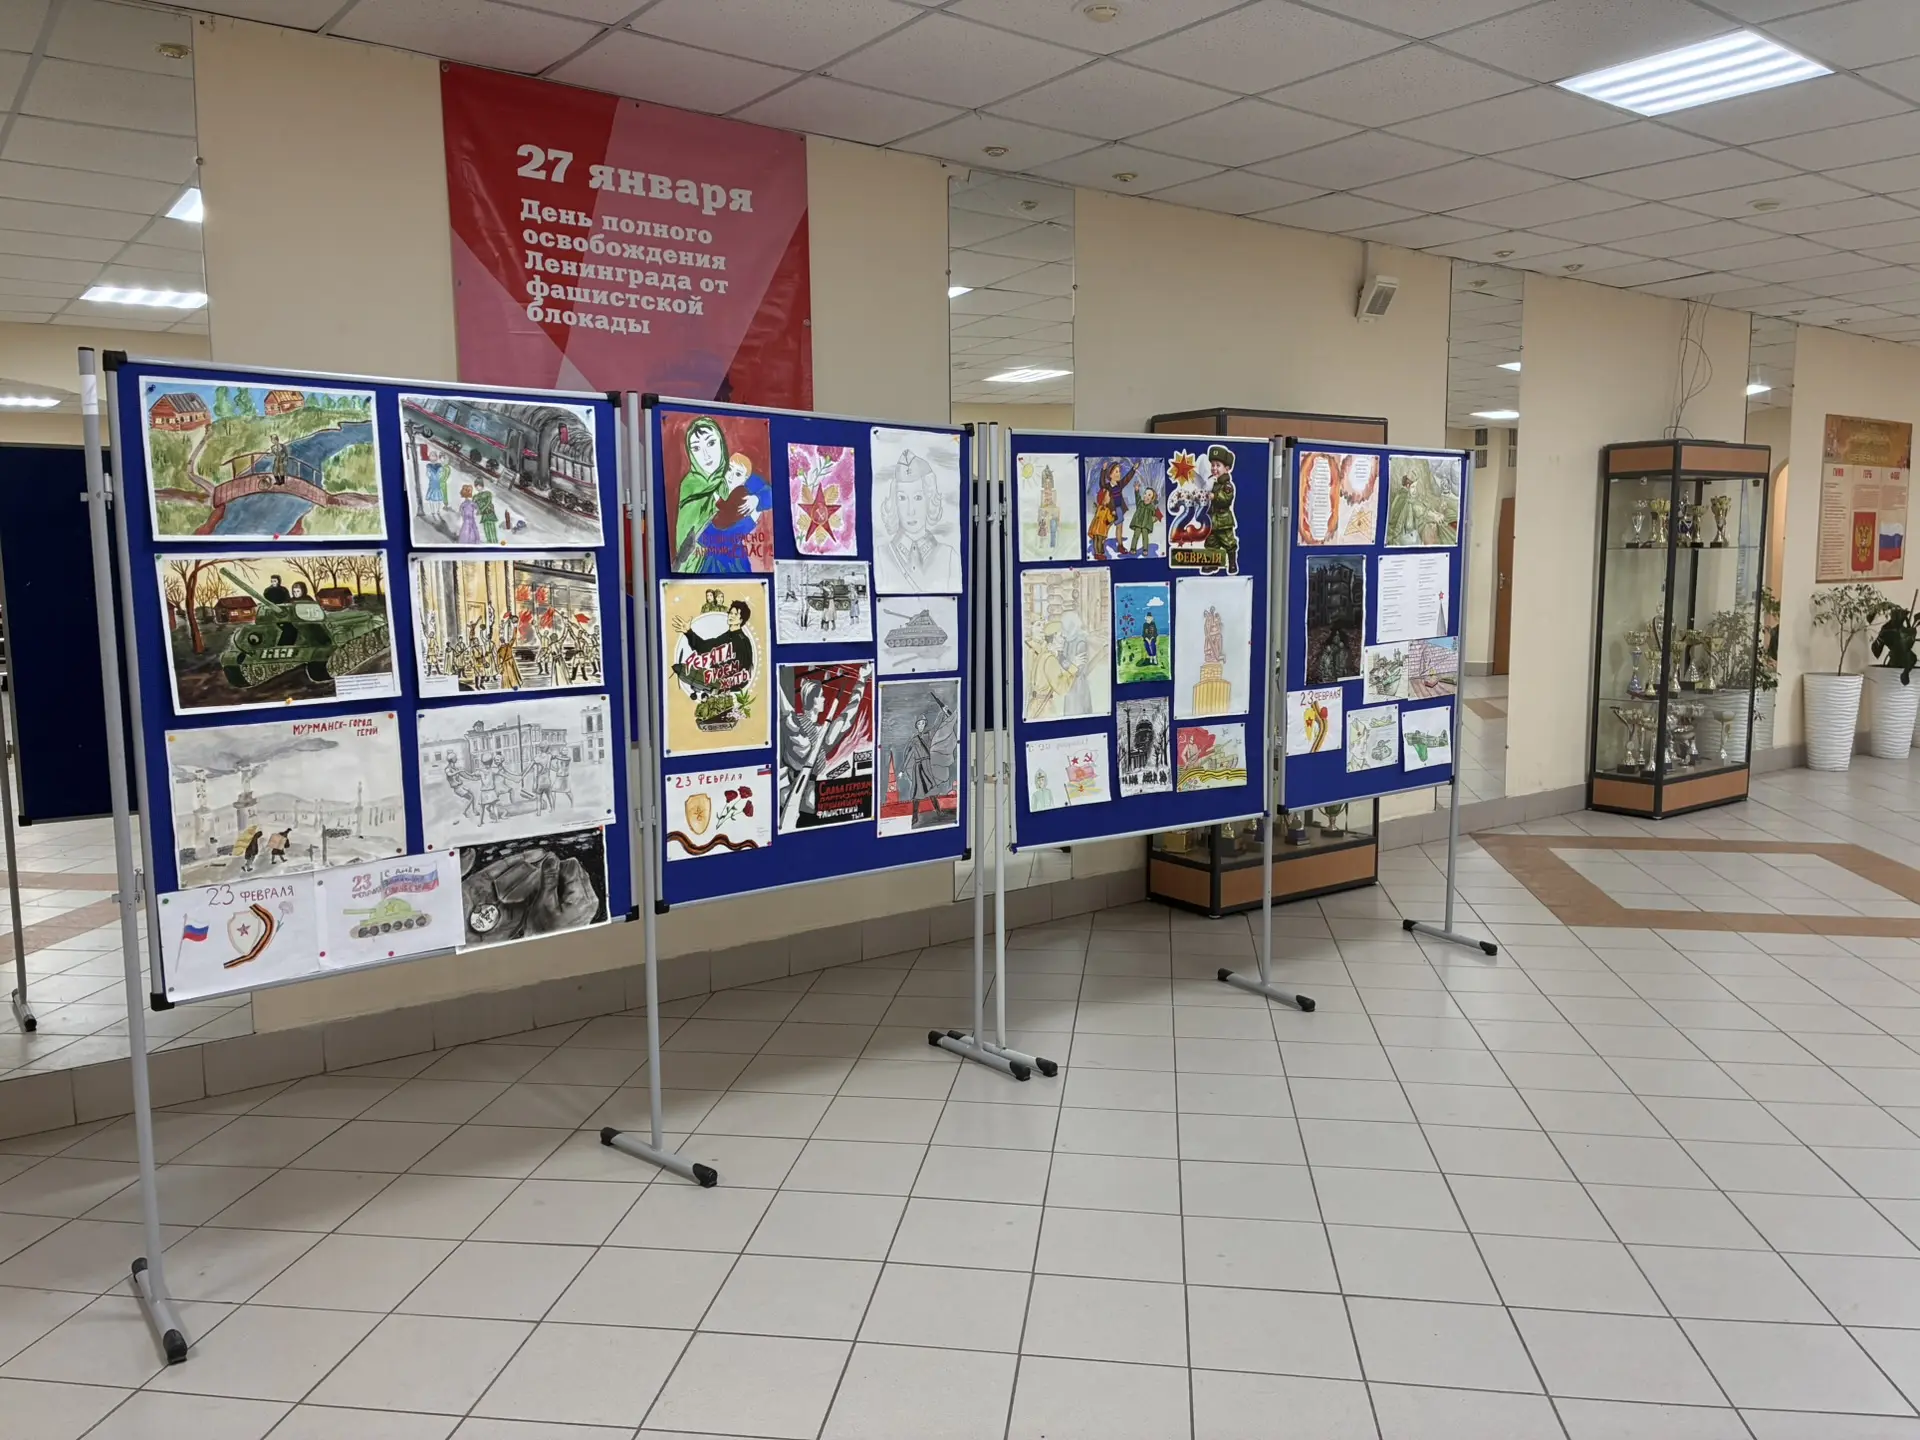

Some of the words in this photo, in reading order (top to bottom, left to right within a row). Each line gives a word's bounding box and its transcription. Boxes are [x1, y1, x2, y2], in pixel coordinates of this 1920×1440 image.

[516, 143, 574, 184] 27
[588, 162, 754, 216] января
[520, 198, 593, 228] День
[601, 213, 713, 244] полного
[522, 228, 727, 271] освобождения
[525, 250, 692, 291] Ленинграда
[699, 277, 729, 295] от
[525, 275, 705, 316] фашистской
[525, 300, 651, 335] блокады
[1167, 487, 1212, 544] 23
[1175, 551, 1222, 563] ФЕВРАЛЯ
[1300, 691, 1314, 706] 23
[356, 726, 379, 736] ГЕРОЙ
[675, 776, 692, 789] 23
[697, 773, 743, 785] ФЕВРАЛЯ
[205, 883, 235, 907] 23
[239, 884, 295, 903] ФЕВРАЛЯ
[351, 872, 373, 893] 23
